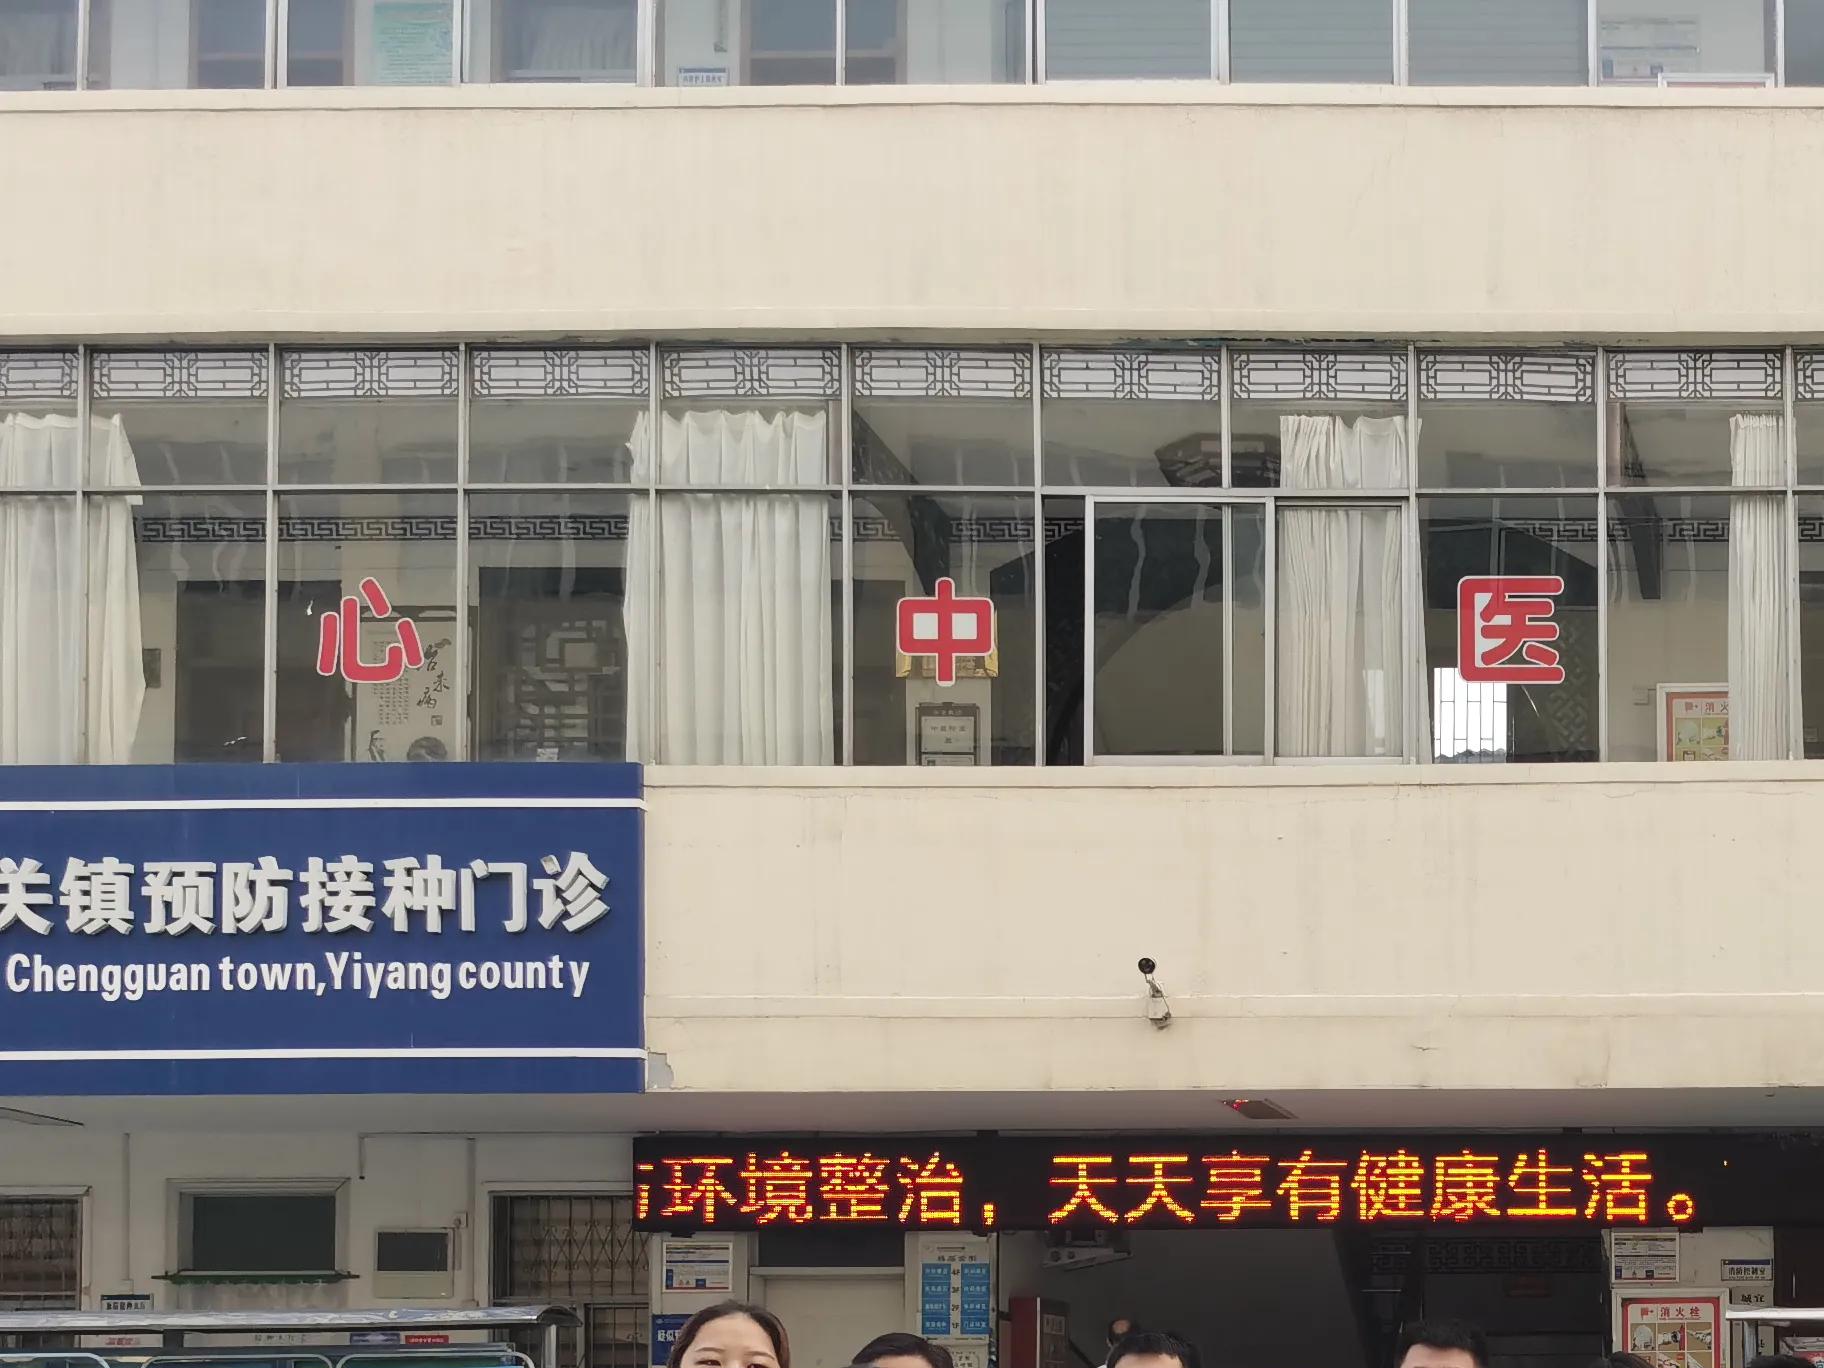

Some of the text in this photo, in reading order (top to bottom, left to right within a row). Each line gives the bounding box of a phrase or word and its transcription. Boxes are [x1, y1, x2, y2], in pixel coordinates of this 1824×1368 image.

[317, 576, 424, 682] 心
[896, 576, 995, 687] 中
[1457, 575, 1565, 683] 医
[0, 852, 611, 936] 关镇预防接种门诊
[6, 952, 210, 1001] Chengguan
[458, 957, 591, 997] county
[1048, 1149, 1697, 1224] 天天享有健康生活。
[1660, 1306, 1701, 1317] 消火栓
